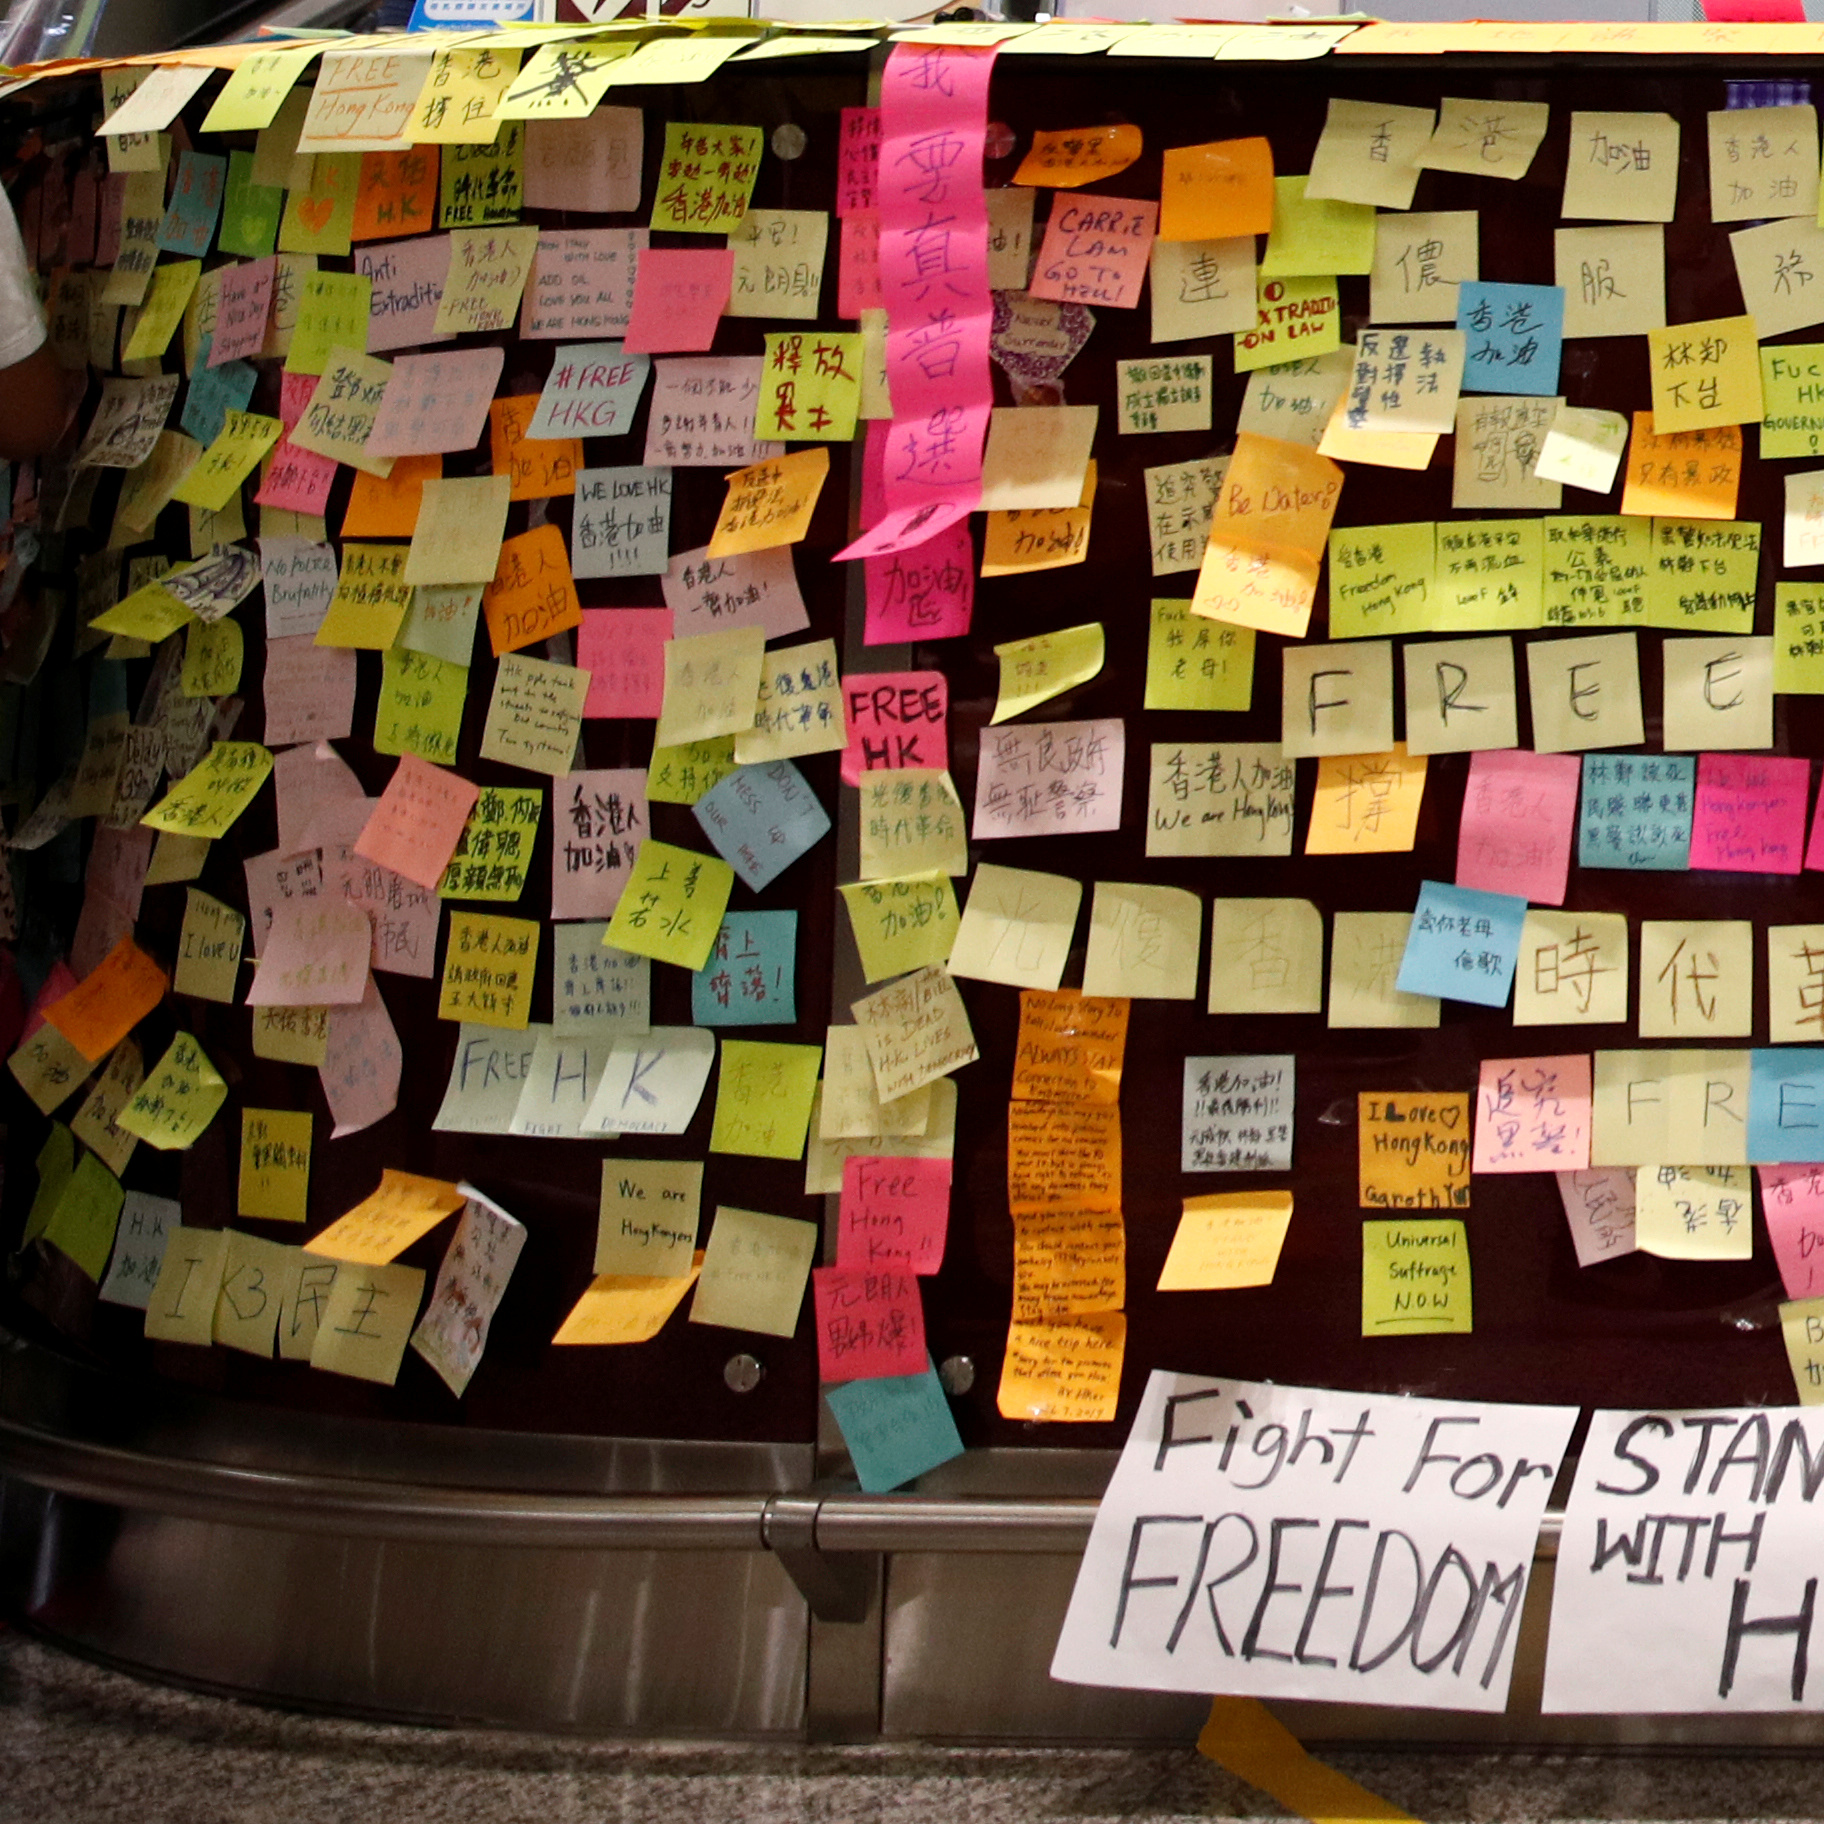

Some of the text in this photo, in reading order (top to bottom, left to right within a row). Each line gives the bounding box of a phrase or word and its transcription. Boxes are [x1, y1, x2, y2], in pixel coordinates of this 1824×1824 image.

[331, 57, 399, 84] FREE
[316, 95, 367, 120] Hong
[1590, 130, 1651, 174] 加油
[1729, 178, 1799, 205] 加油
[1045, 263, 1084, 283] GO
[1469, 302, 1544, 333] 香港
[555, 362, 634, 390] #FREE
[548, 399, 618, 427] HKG
[581, 478, 672, 501] WE LOVE HK
[850, 684, 947, 722] FREE
[860, 733, 924, 769] HK
[618, 1179, 647, 1202] We
[1385, 1231, 1457, 1249] Universal
[1388, 1260, 1458, 1281] Suffrage
[1153, 1388, 1553, 1510] Fight For
[1590, 1512, 1763, 1586] WITH
[1108, 1512, 1527, 1692] FREEDOM
